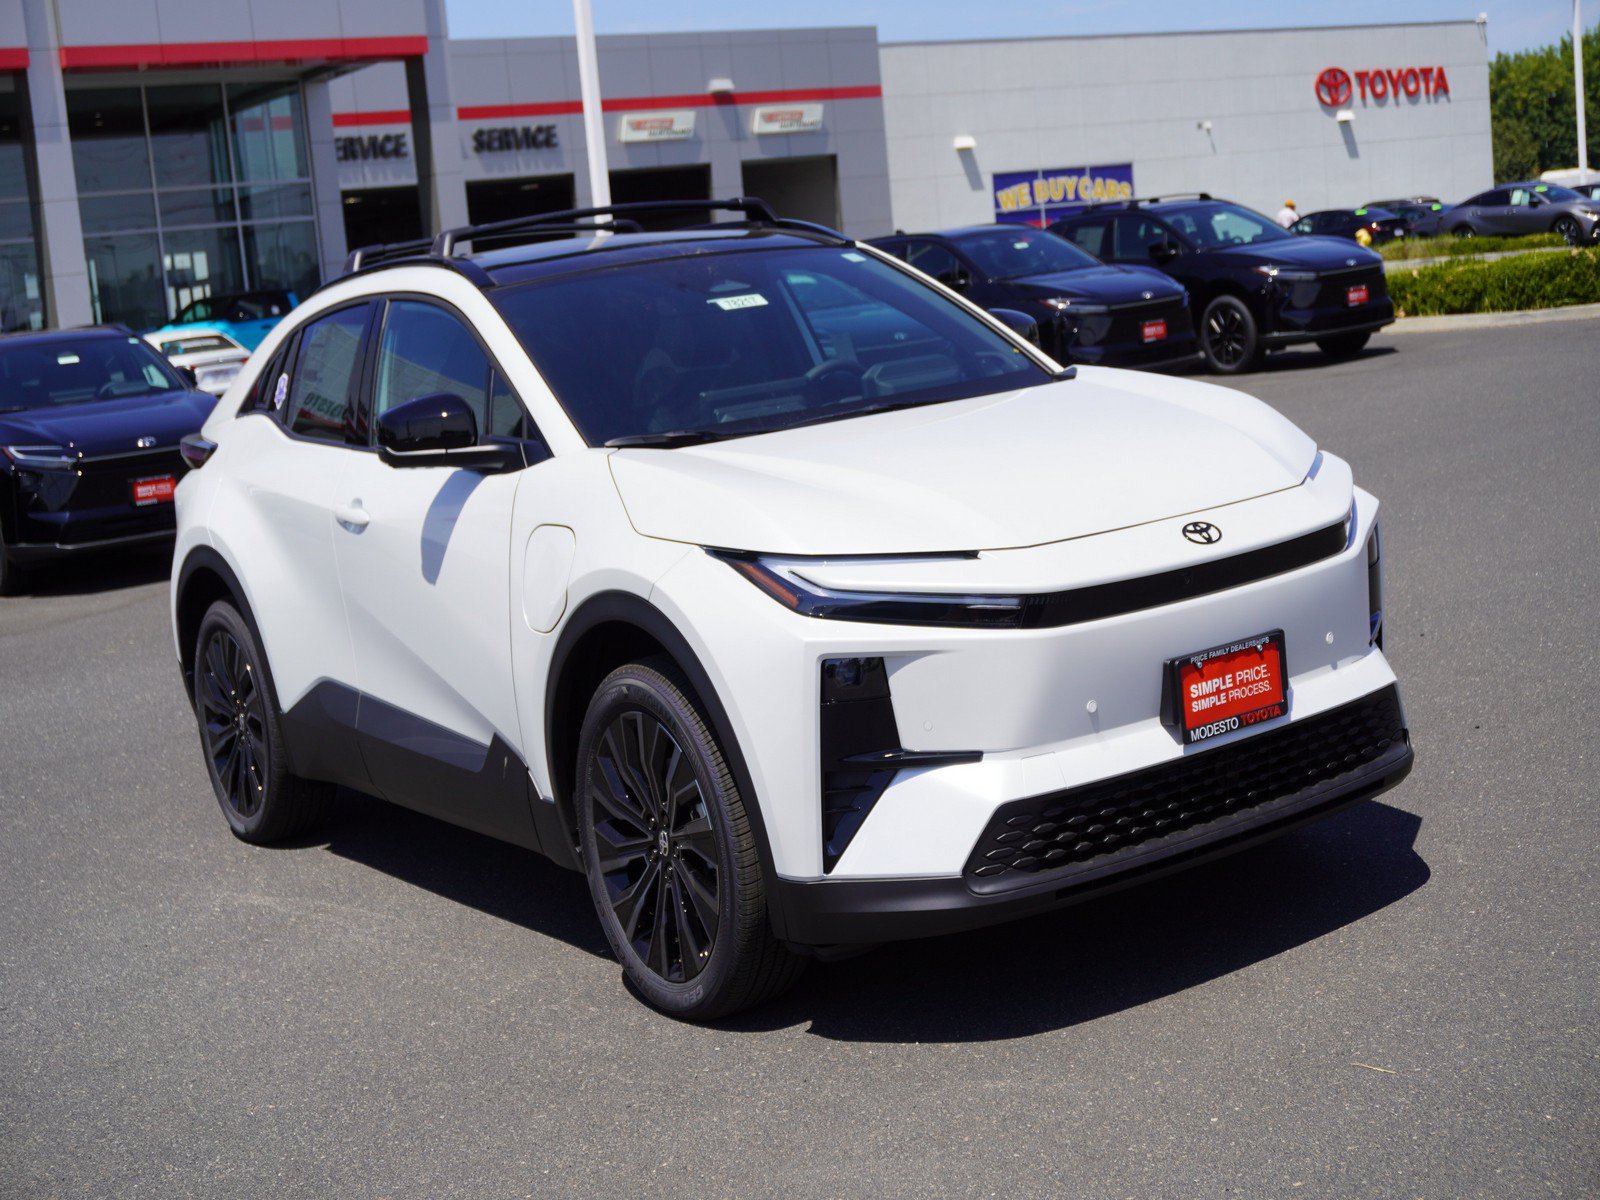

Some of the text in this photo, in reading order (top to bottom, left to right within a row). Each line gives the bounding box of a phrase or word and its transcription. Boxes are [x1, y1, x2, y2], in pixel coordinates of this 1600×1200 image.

[1354, 67, 1450, 99] TOYOTA
[335, 133, 407, 162] ERVICE
[473, 125, 558, 153] SERVICE
[996, 176, 1132, 210] WE BUY CARS
[1190, 636, 1270, 664] PRICE FAMILY DEALERSHIPS
[1190, 664, 1271, 698] SIMPLE PRICE.
[1192, 680, 1272, 712] SIMPLE PROCESS.
[1190, 705, 1281, 742] MODESTO TOYOTA
